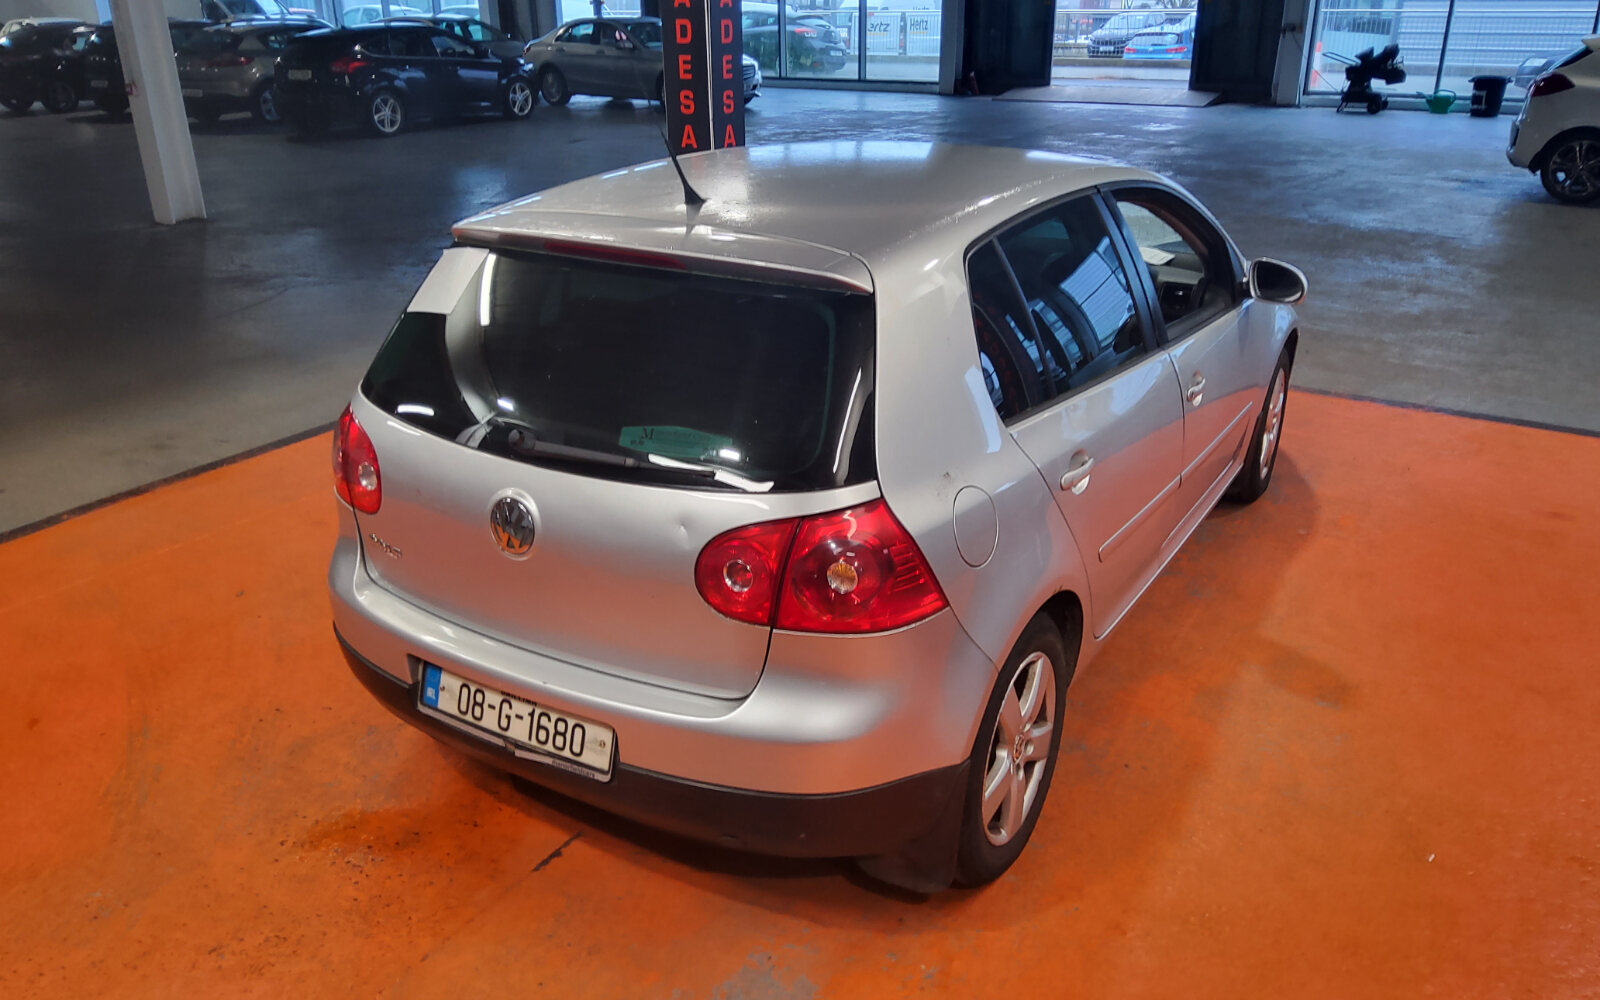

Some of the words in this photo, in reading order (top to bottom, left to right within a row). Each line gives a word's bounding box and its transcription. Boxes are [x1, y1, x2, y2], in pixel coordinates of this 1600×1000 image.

[867, 21, 890, 32] ertz
[909, 18, 929, 31] Hertz
[457, 682, 586, 758] 08-G-1680
